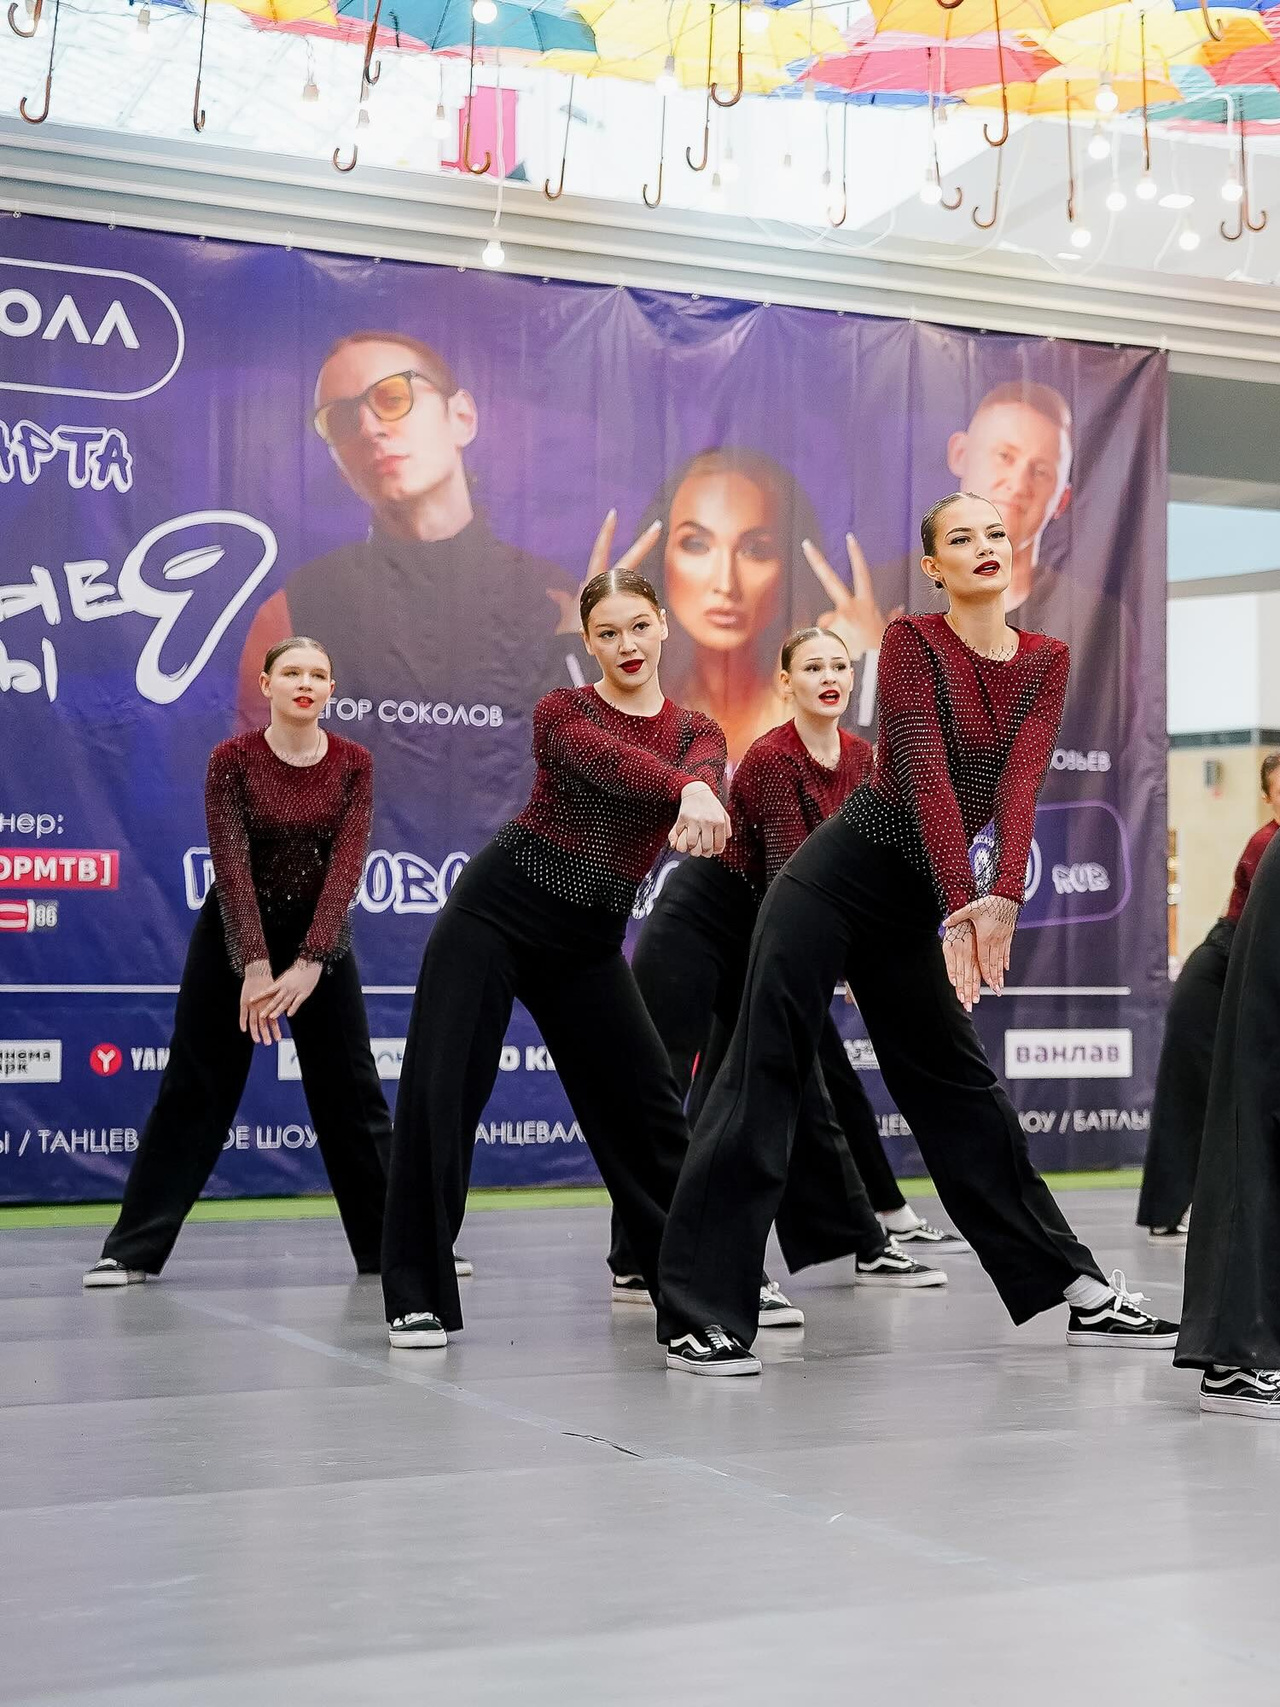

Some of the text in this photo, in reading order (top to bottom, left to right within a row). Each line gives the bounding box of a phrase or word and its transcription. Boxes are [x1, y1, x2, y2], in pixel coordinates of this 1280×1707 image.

[319, 697, 504, 727] ГОР СОКОЛОВ
[1052, 862, 1112, 894] RUB
